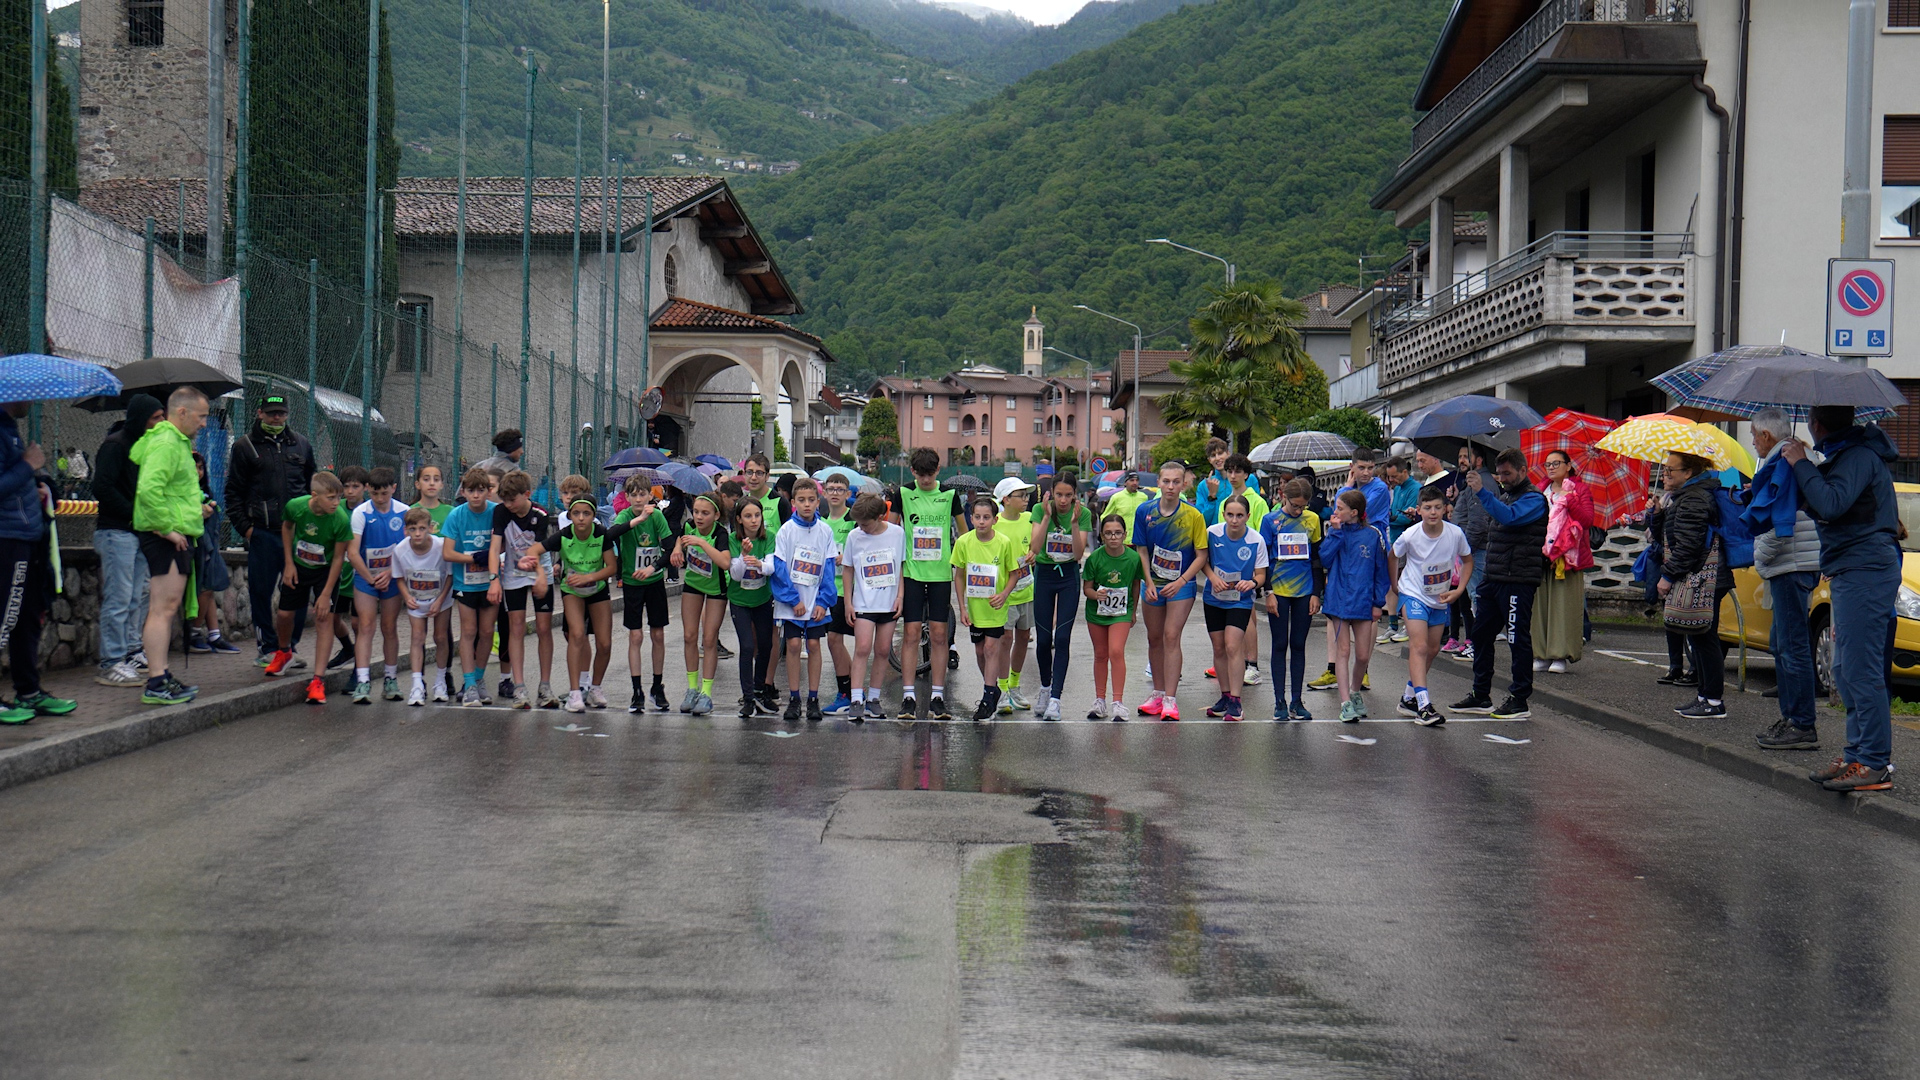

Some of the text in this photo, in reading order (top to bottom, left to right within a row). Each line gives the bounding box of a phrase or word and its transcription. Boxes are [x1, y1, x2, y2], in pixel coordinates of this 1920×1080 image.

[1839, 331, 1850, 345] P
[917, 538, 937, 549] 805
[1051, 542, 1072, 553] 719
[1287, 545, 1300, 555] 18
[797, 561, 817, 575] 221
[1157, 557, 1176, 570] 776
[867, 564, 888, 577] 230
[971, 576, 991, 586] 948
[1427, 572, 1449, 585] 313
[1507, 595, 1518, 644] GIVOVA
